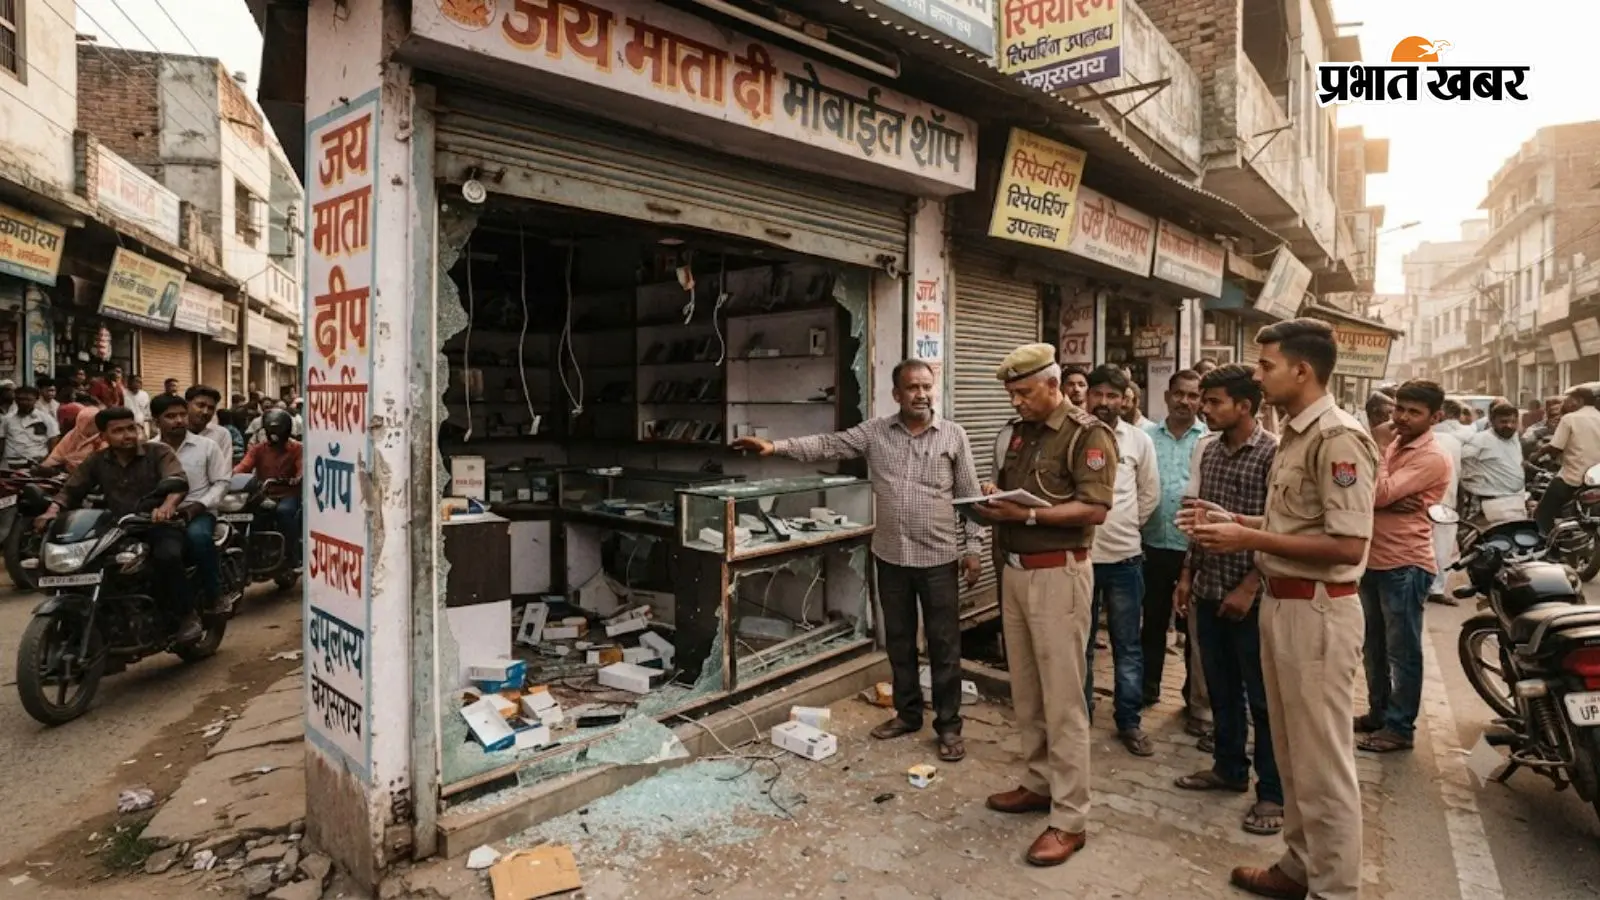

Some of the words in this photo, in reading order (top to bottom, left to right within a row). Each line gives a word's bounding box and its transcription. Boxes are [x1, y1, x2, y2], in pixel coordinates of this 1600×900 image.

[502, 0, 616, 73] जय
[624, 18, 729, 106] माता
[782, 62, 906, 156] मोबाईल
[910, 108, 965, 172] शॉप
[319, 114, 371, 187] जय
[312, 185, 372, 258] माता
[313, 442, 355, 512] शॉप
